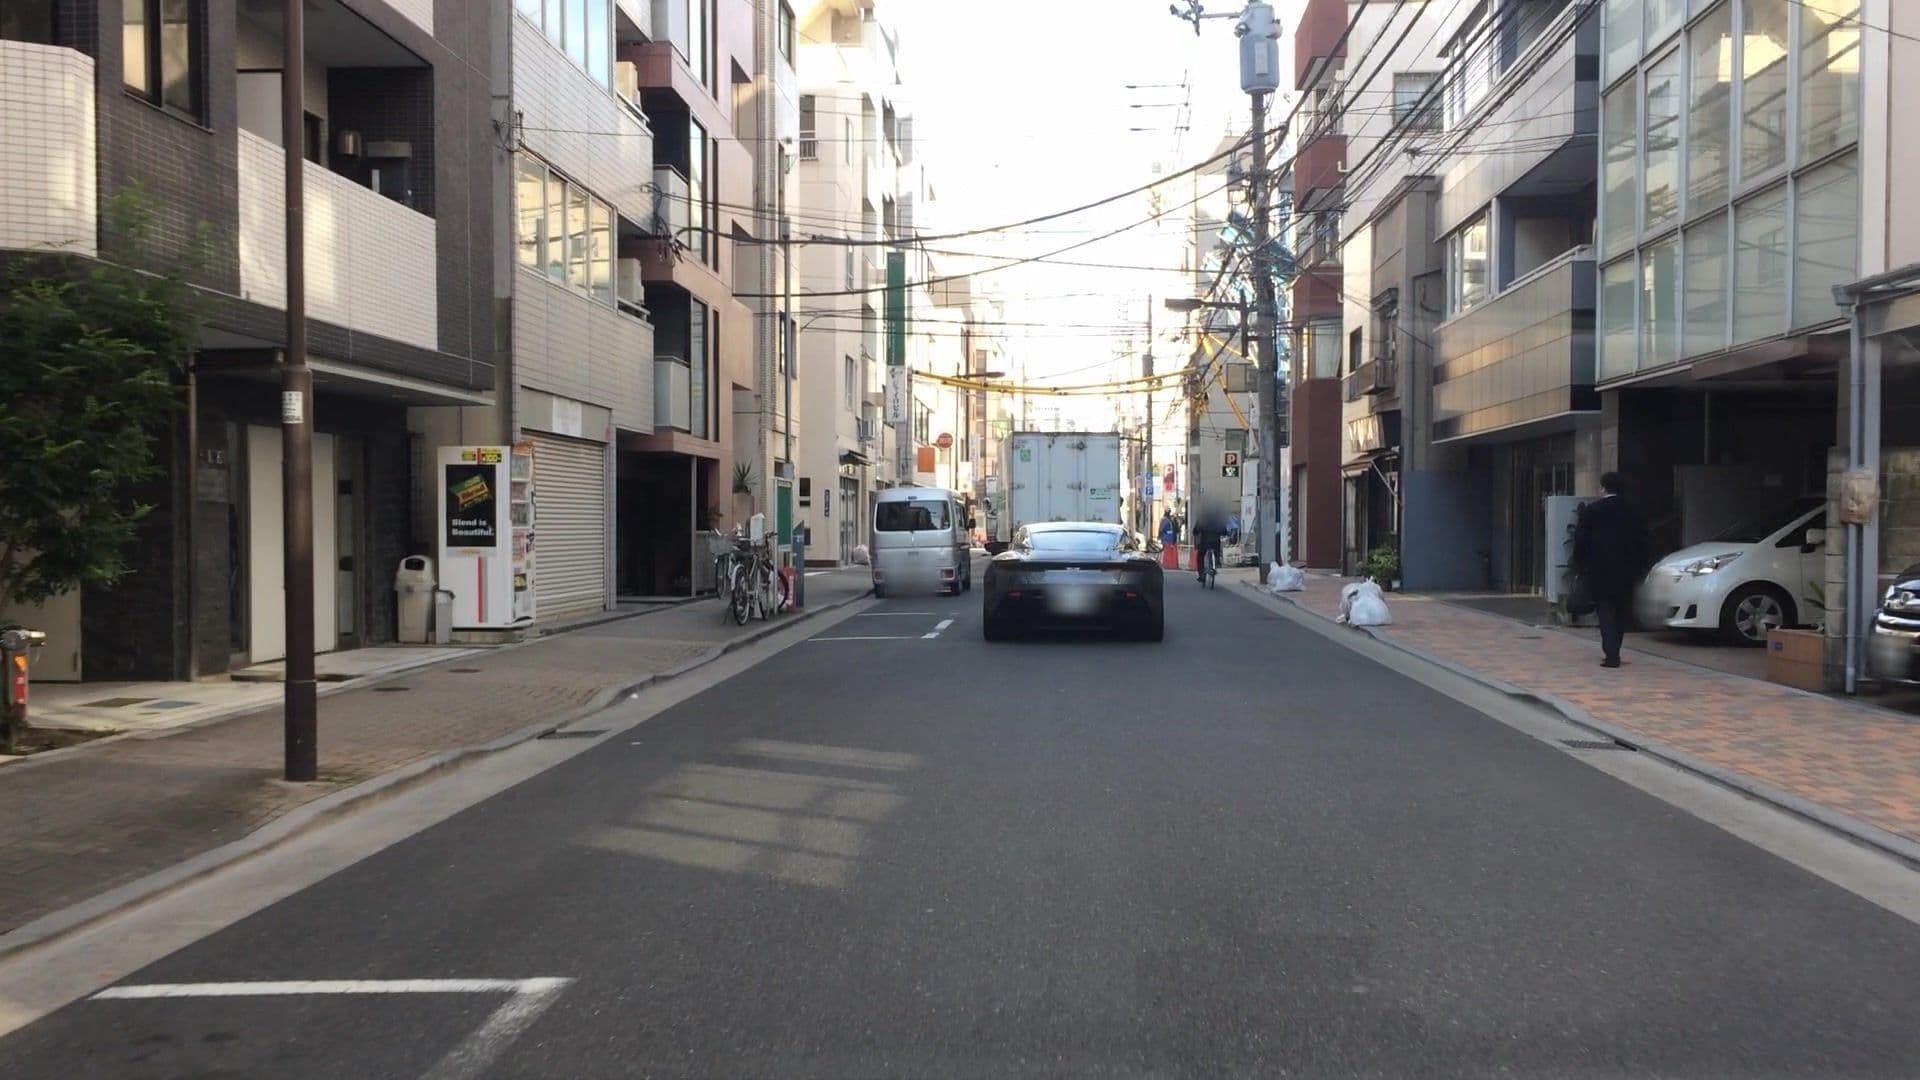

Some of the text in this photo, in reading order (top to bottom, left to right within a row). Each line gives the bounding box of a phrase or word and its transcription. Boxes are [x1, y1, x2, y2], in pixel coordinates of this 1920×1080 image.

[452, 518, 487, 526] Blend is
[452, 527, 494, 536] Beautiful.
